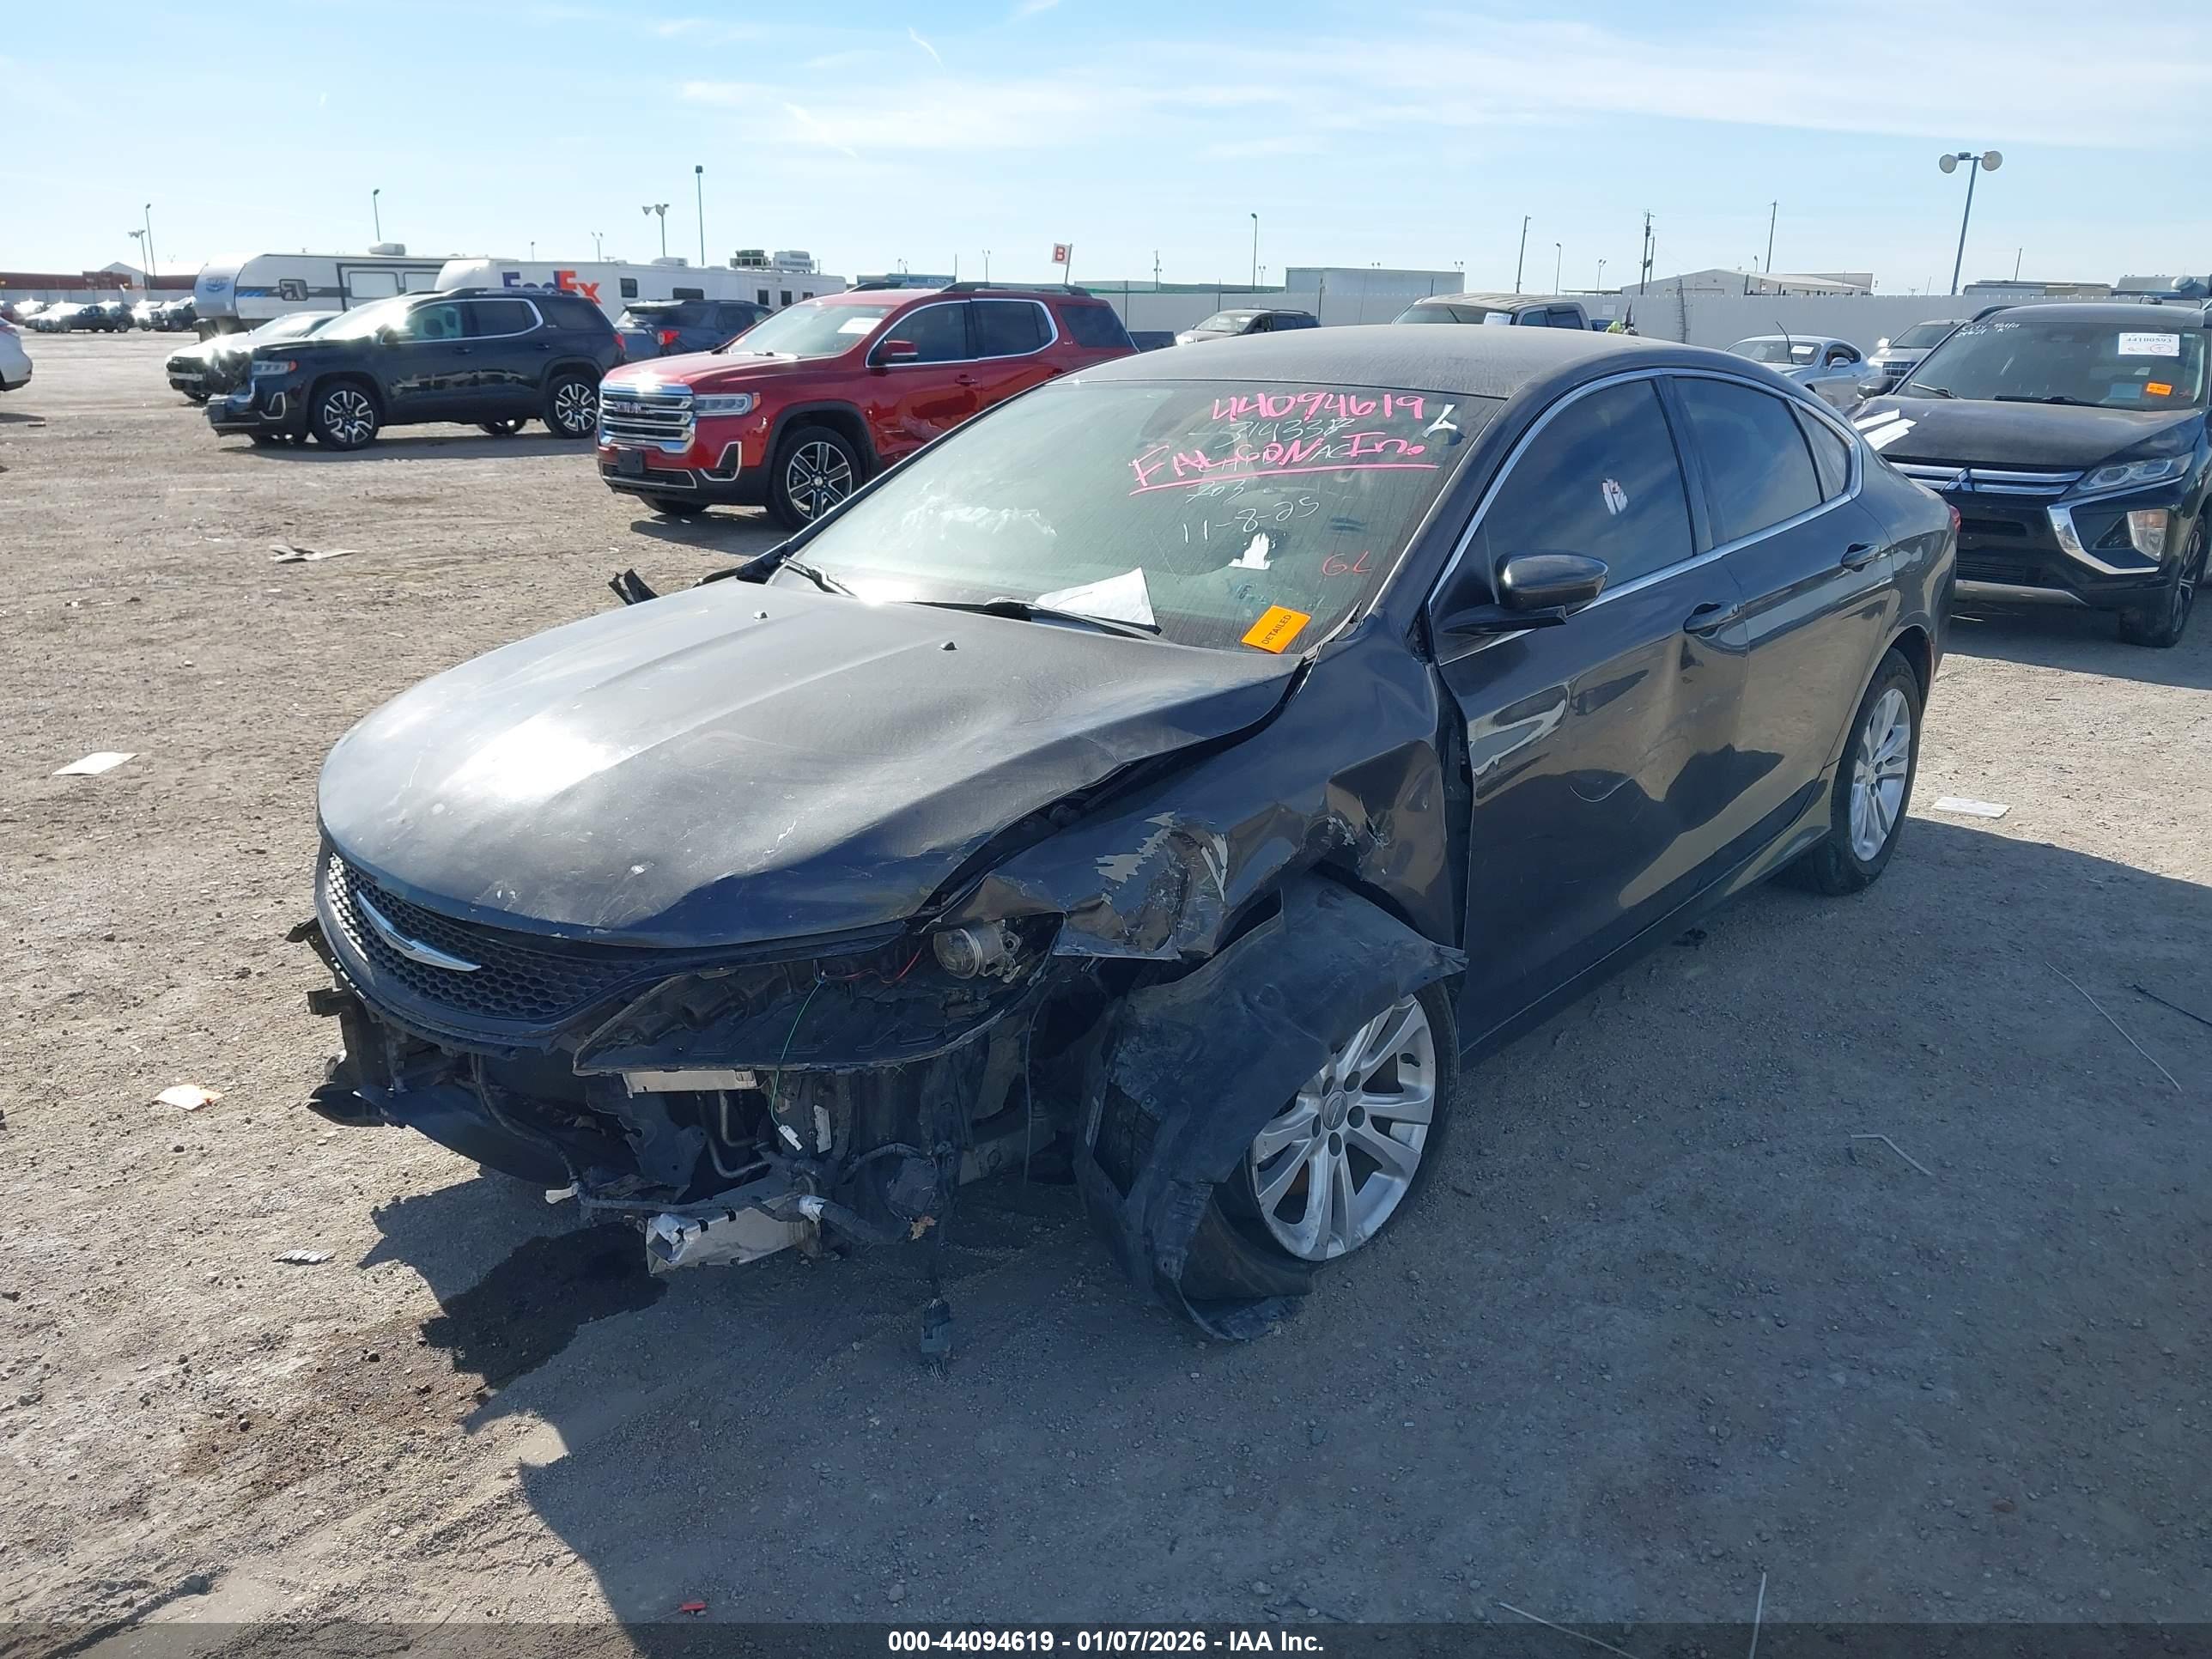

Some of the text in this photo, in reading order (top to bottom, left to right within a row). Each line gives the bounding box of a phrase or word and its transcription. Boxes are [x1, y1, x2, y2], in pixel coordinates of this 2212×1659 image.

[1054, 246, 1066, 261] B
[502, 270, 602, 304] FEx
[1212, 393, 1425, 421] 44094619
[1261, 614, 1292, 645] DETAILED
